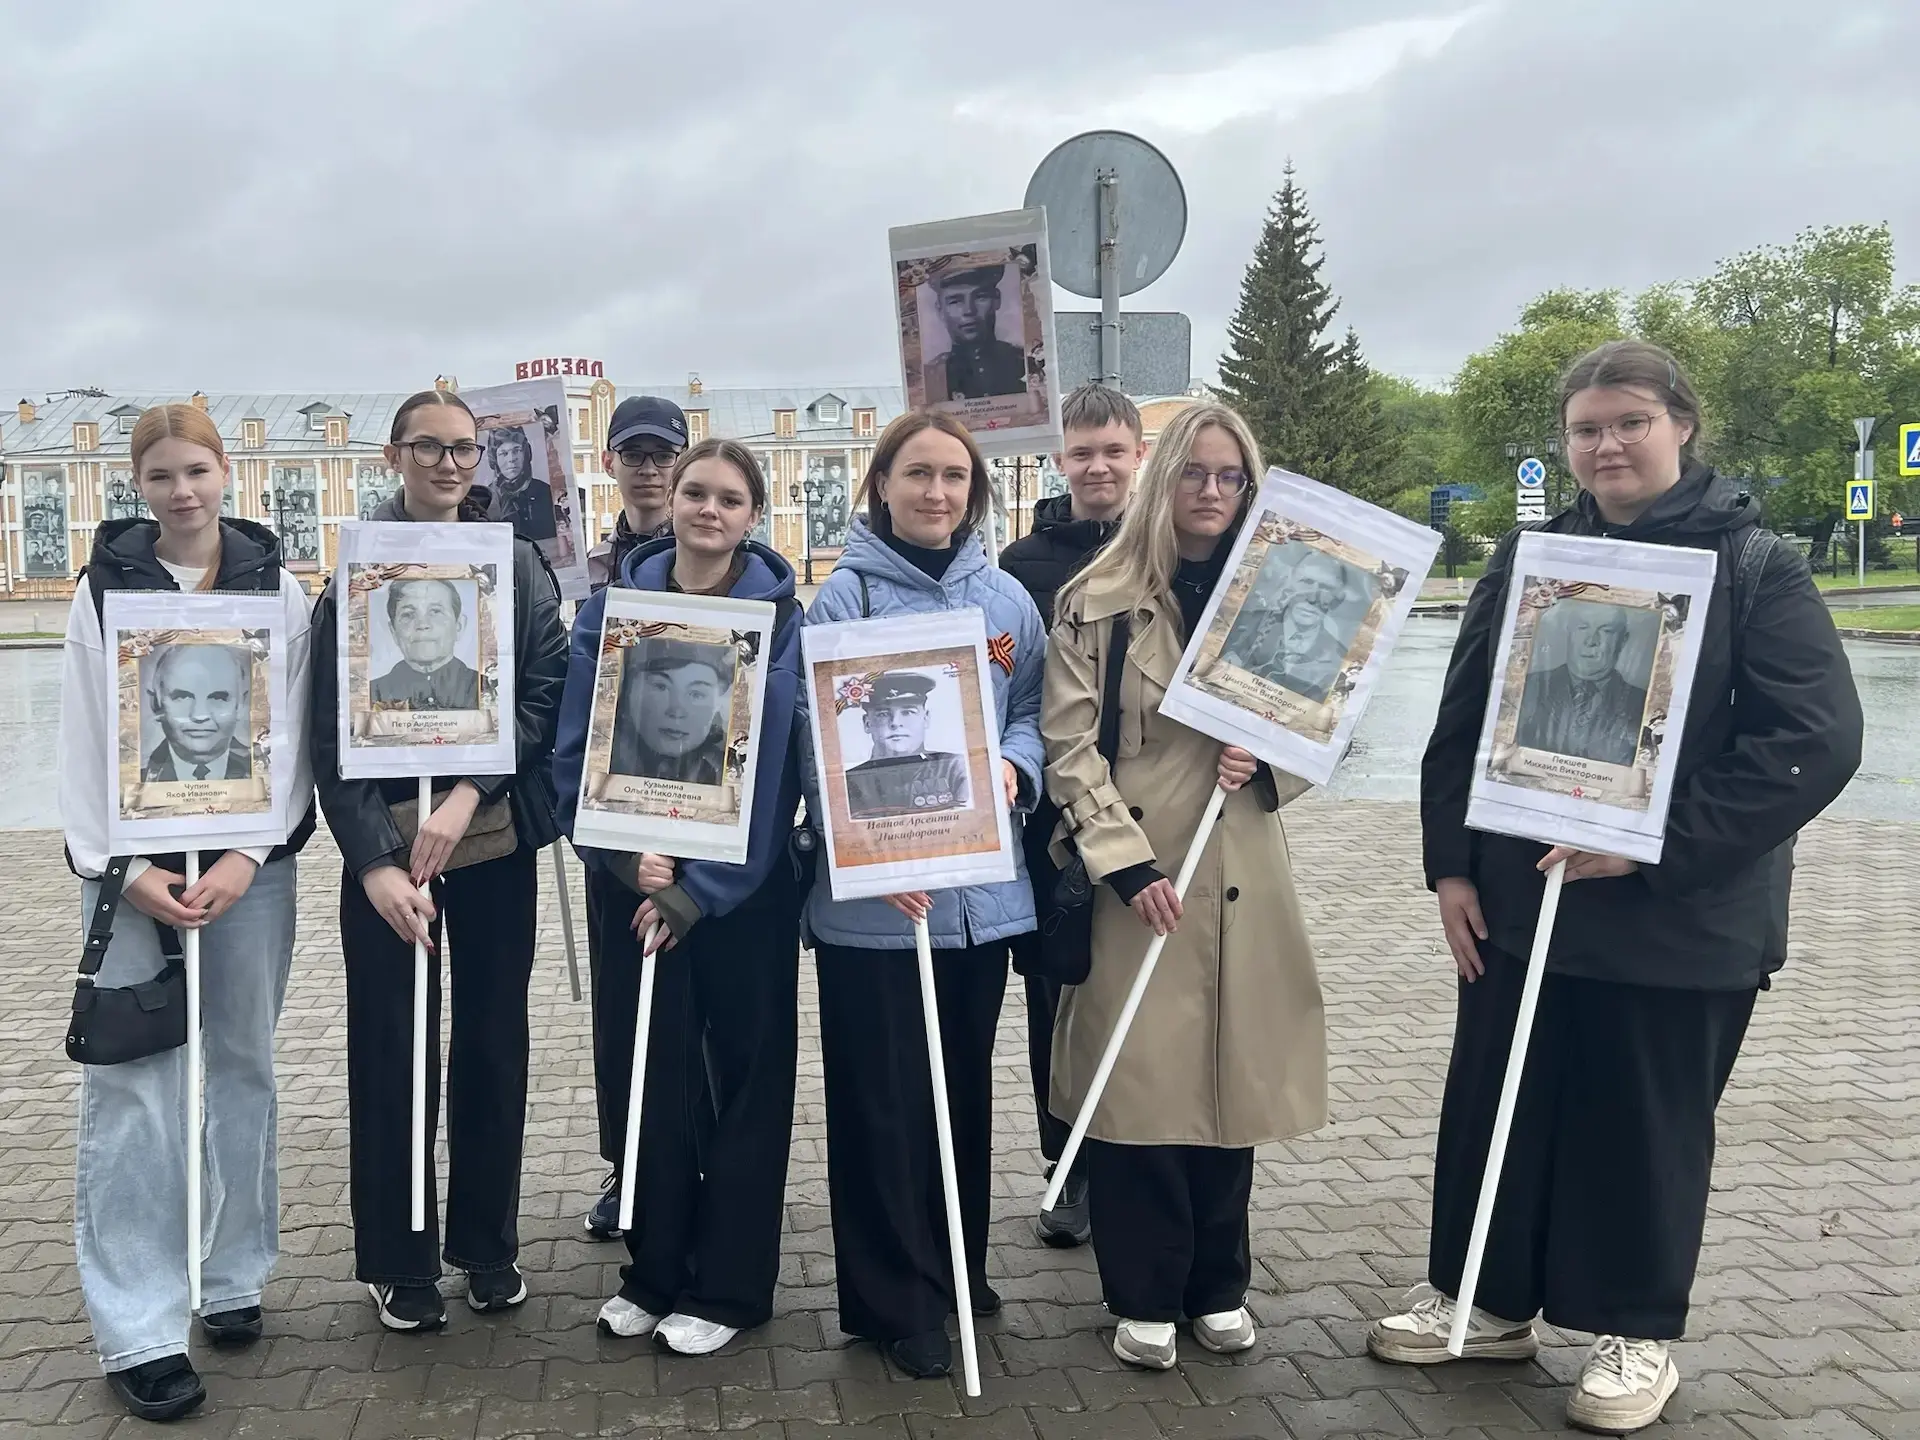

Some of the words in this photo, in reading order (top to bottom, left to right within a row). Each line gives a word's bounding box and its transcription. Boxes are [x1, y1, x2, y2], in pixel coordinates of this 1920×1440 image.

[516, 358, 603, 380] ВОКЗАЛ
[1222, 673, 1258, 693] Дмитрий
[1259, 688, 1307, 715] Викторович
[1252, 677, 1284, 696] Пекшев
[1552, 755, 1587, 769] Пекшев
[1523, 759, 1557, 772] Михаил
[1559, 765, 1613, 783] Викторович
[184, 783, 209, 791] Чупин
[623, 786, 649, 795] Ольга
[650, 789, 702, 801] Николаевна
[643, 780, 684, 791] Кузьмина
[866, 820, 904, 830] Иванов
[906, 812, 960, 827] Арсентий
[878, 827, 951, 842] Никифорович
